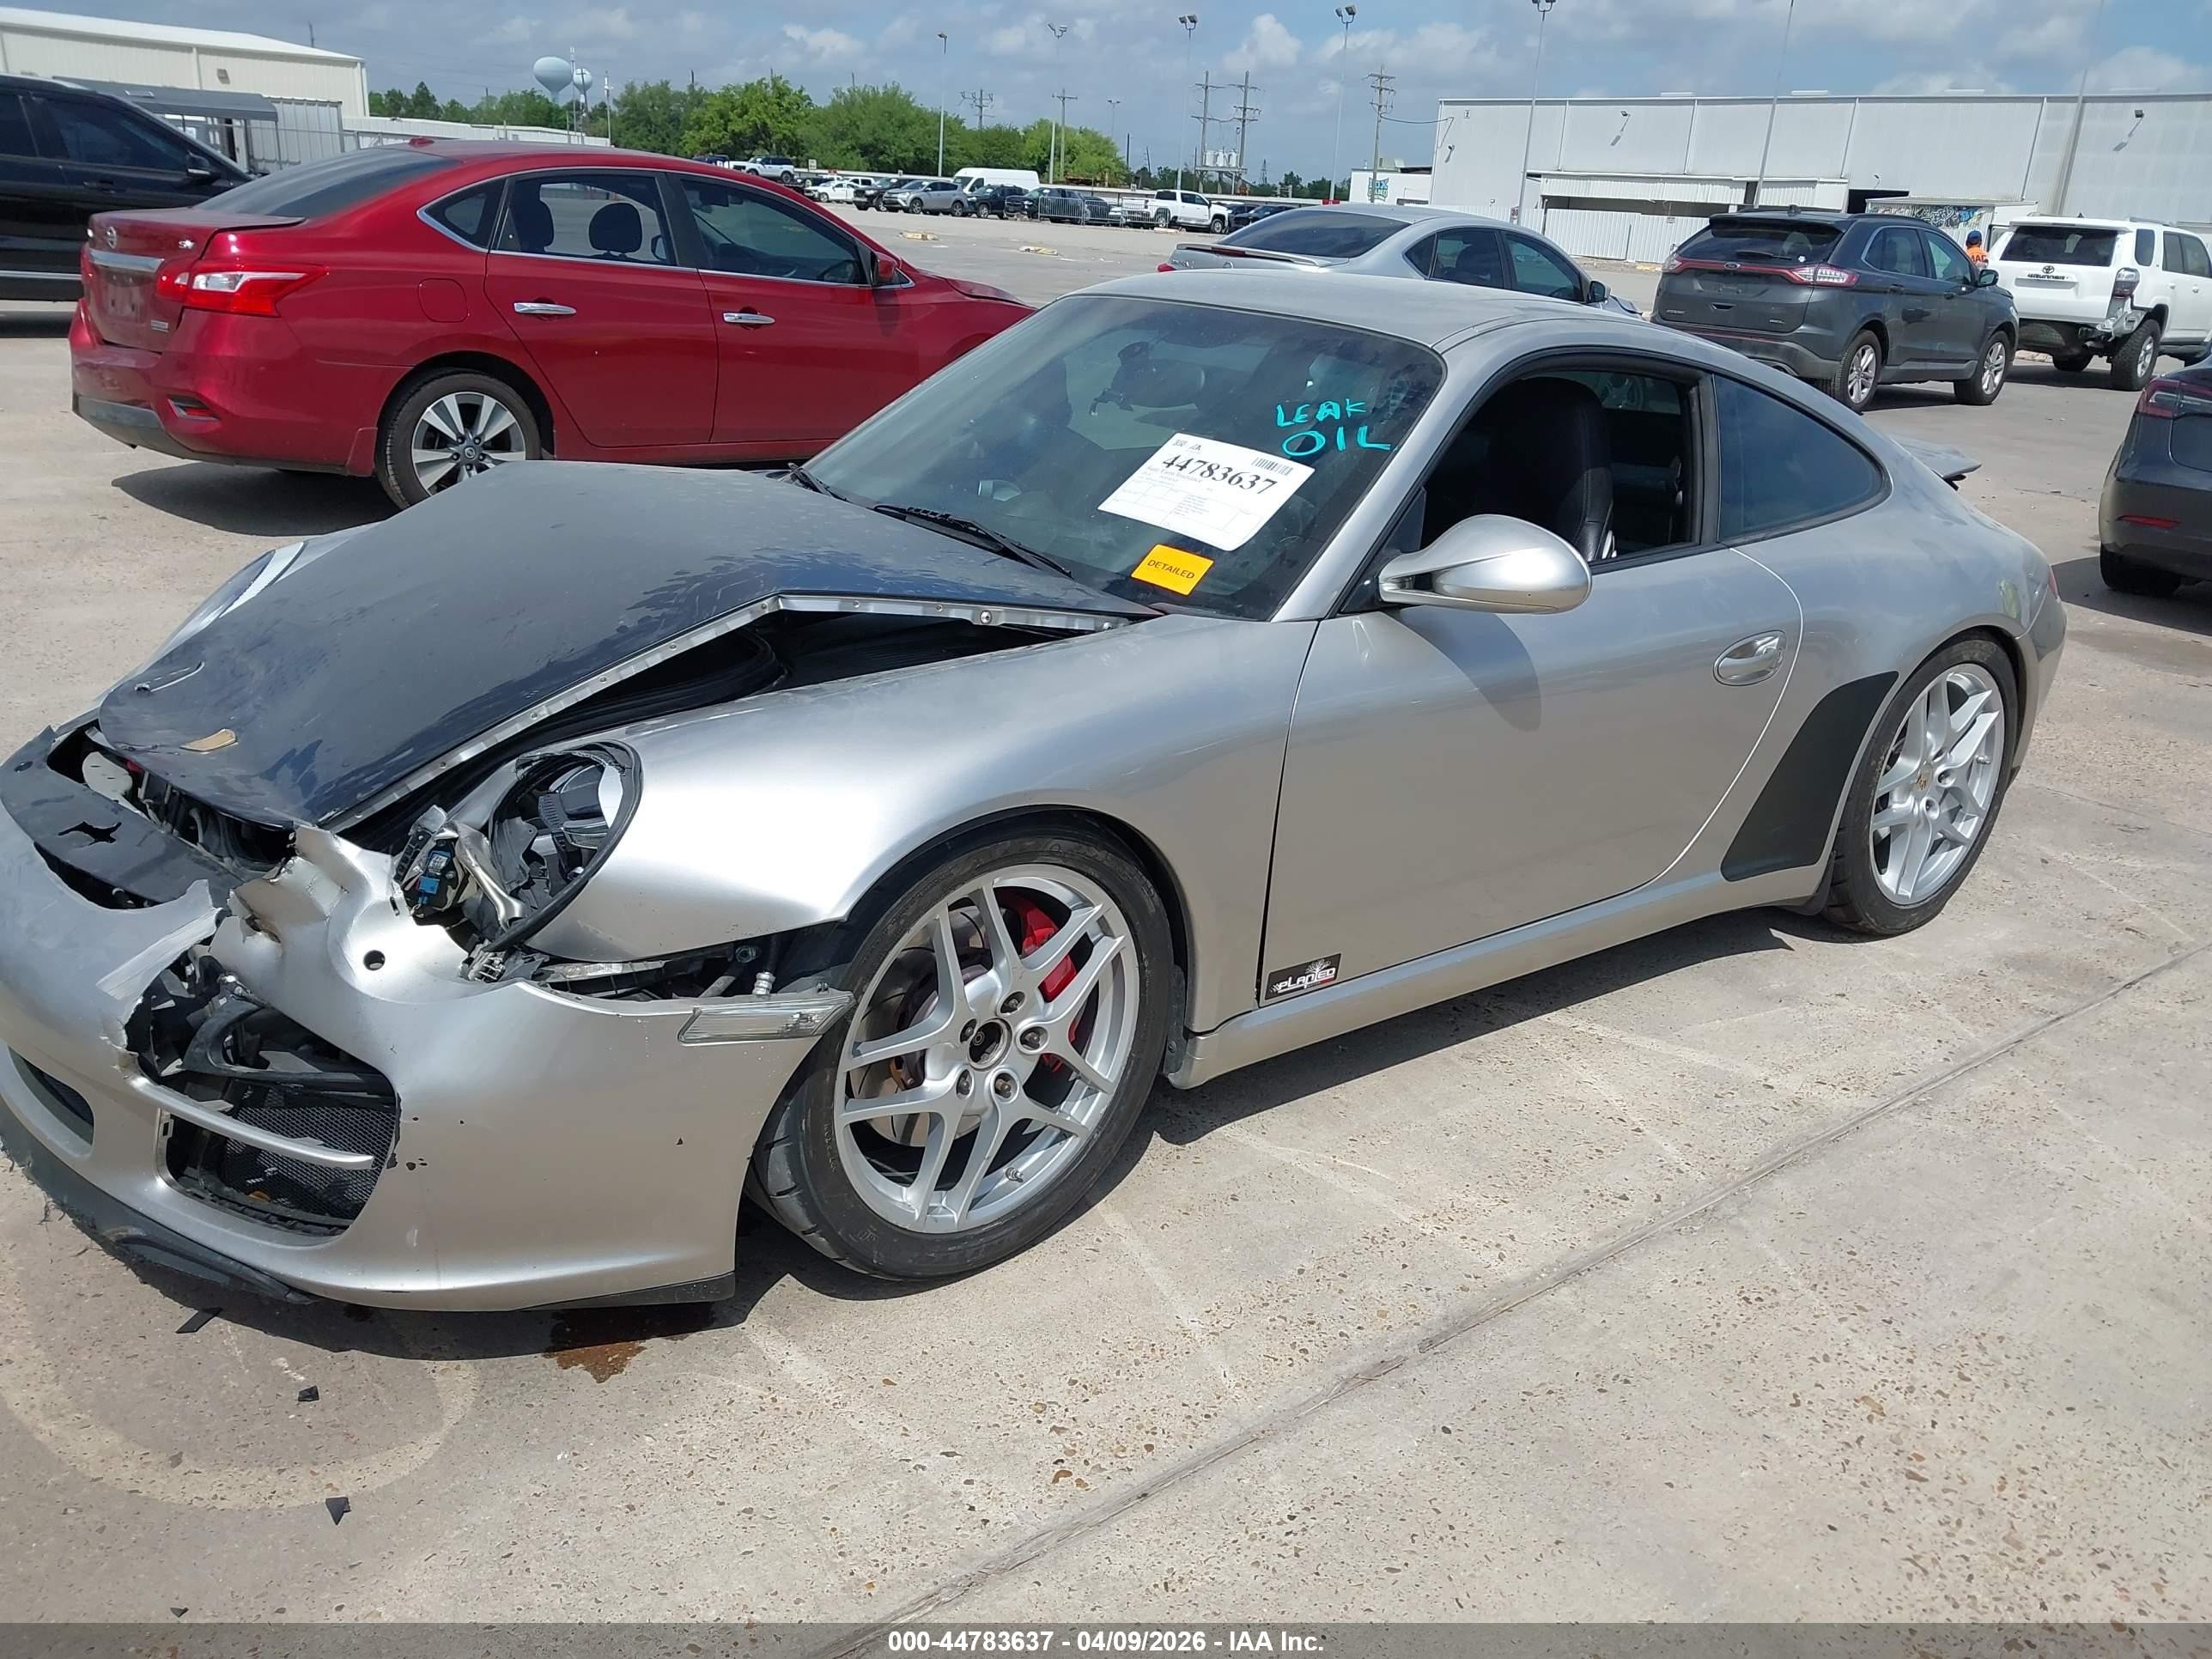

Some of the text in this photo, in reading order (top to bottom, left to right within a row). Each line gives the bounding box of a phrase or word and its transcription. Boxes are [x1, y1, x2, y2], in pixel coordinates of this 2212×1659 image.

[1277, 398, 1366, 427] LEAK
[1282, 425, 1391, 456] OIL
[1163, 454, 1278, 495] 44783637
[1146, 559, 1195, 579] DETAILED
